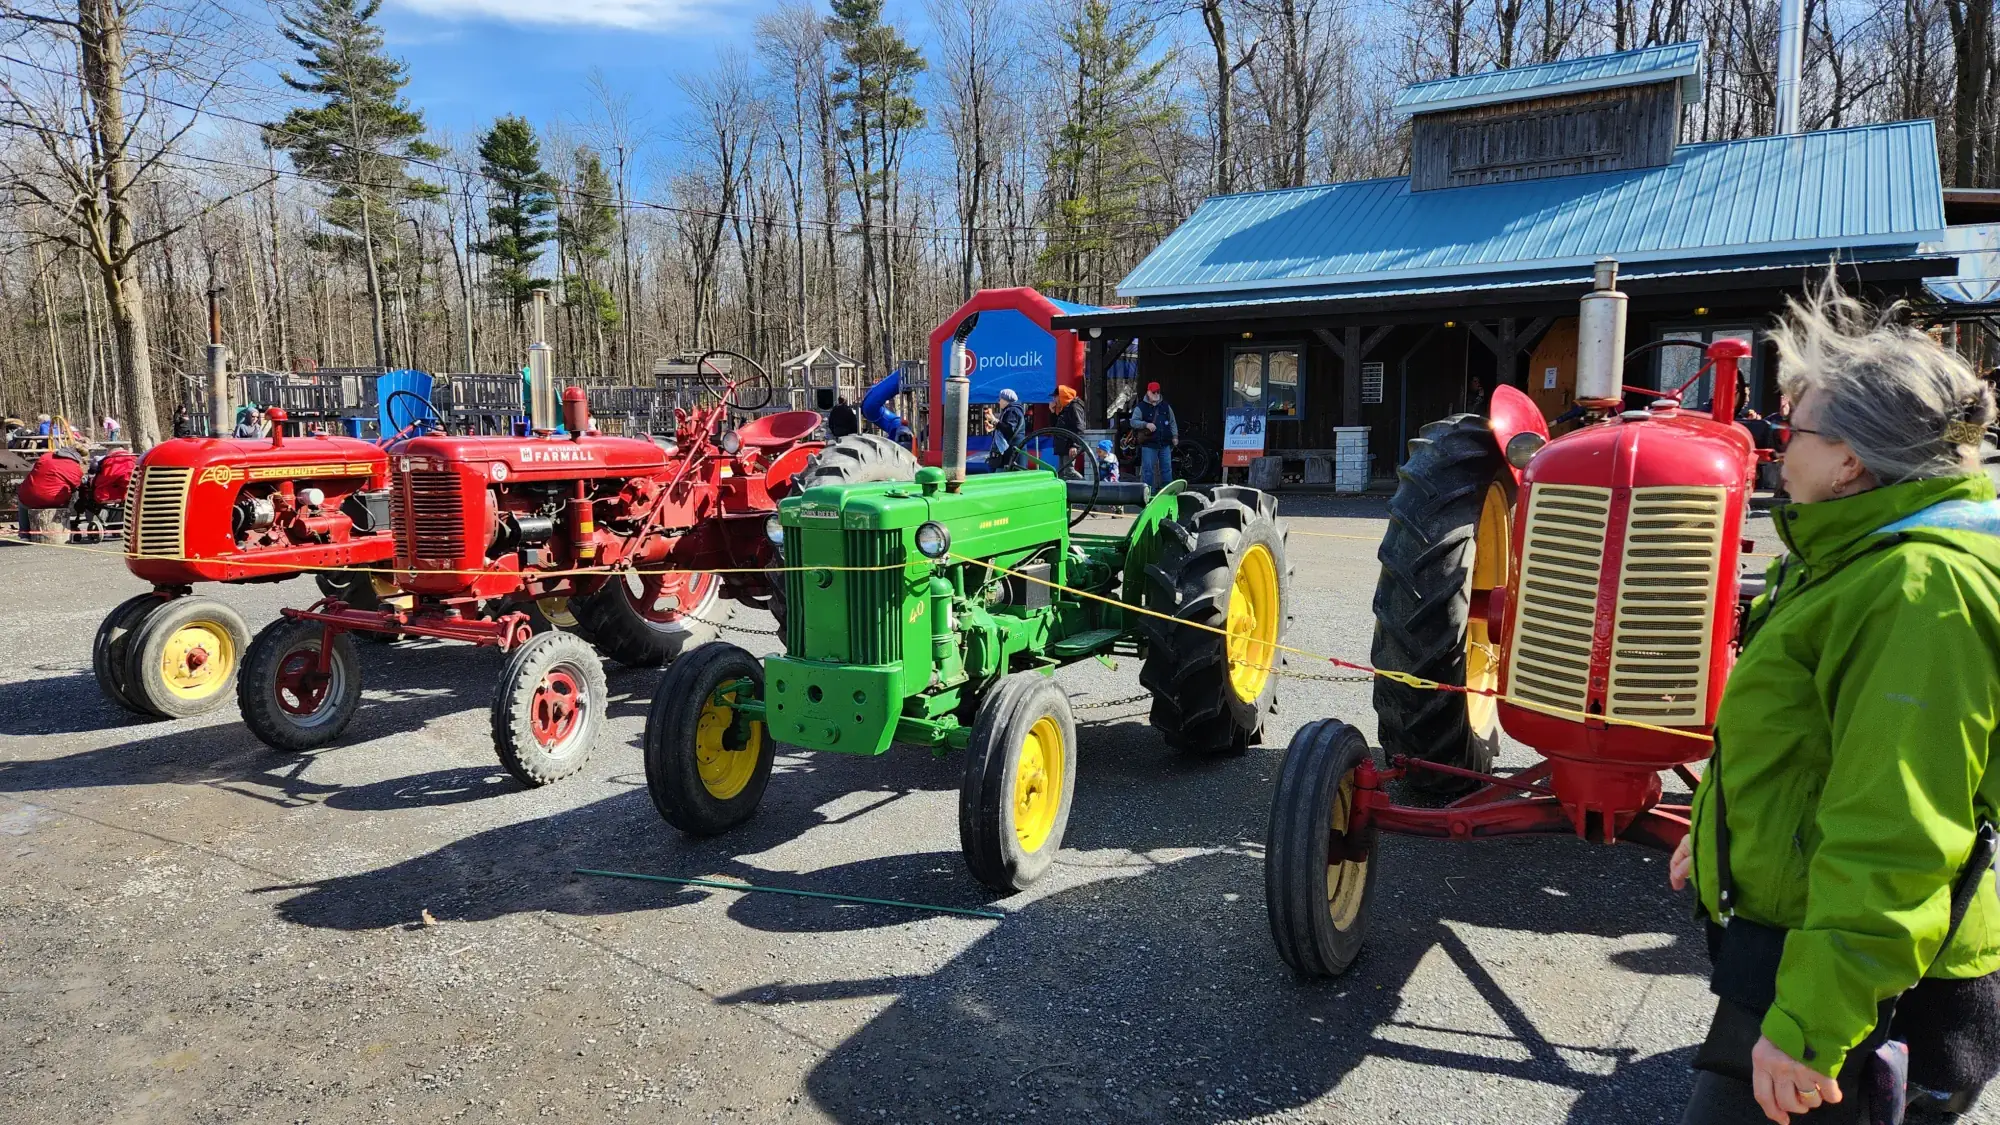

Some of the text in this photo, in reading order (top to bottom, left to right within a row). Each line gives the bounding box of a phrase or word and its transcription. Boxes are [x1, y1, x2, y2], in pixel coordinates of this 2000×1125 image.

[979, 351, 1043, 371] proludik
[534, 451, 594, 462] FARMALL
[216, 468, 229, 480] 20
[262, 467, 317, 476] COCKSHUTT
[817, 510, 838, 518] DEERE
[908, 600, 924, 623] 40
